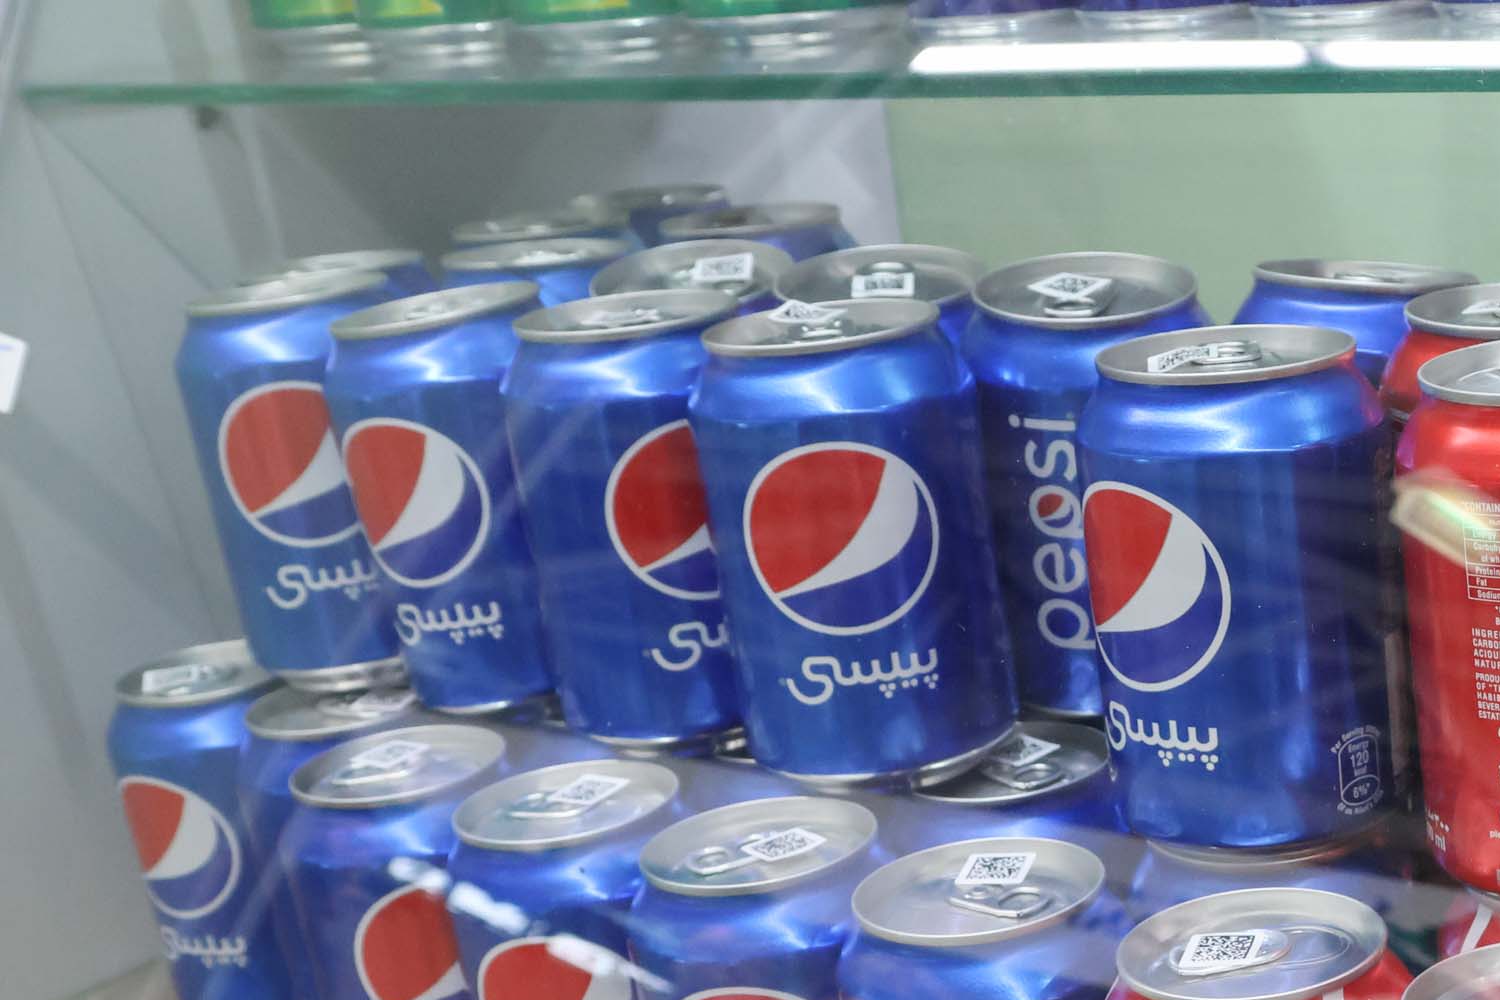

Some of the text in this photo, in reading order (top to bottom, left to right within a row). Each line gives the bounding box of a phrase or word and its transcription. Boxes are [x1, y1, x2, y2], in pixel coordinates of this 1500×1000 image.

[1008, 413, 1097, 650] pepsi
[1475, 567, 1500, 576] Protein
[1475, 577, 1488, 587] Fat
[394, 601, 503, 646] پیپسی
[787, 647, 939, 705] پیپسی
[1476, 681, 1487, 691] OF
[1104, 699, 1219, 771] پیپسی
[1350, 750, 1370, 769] 120
